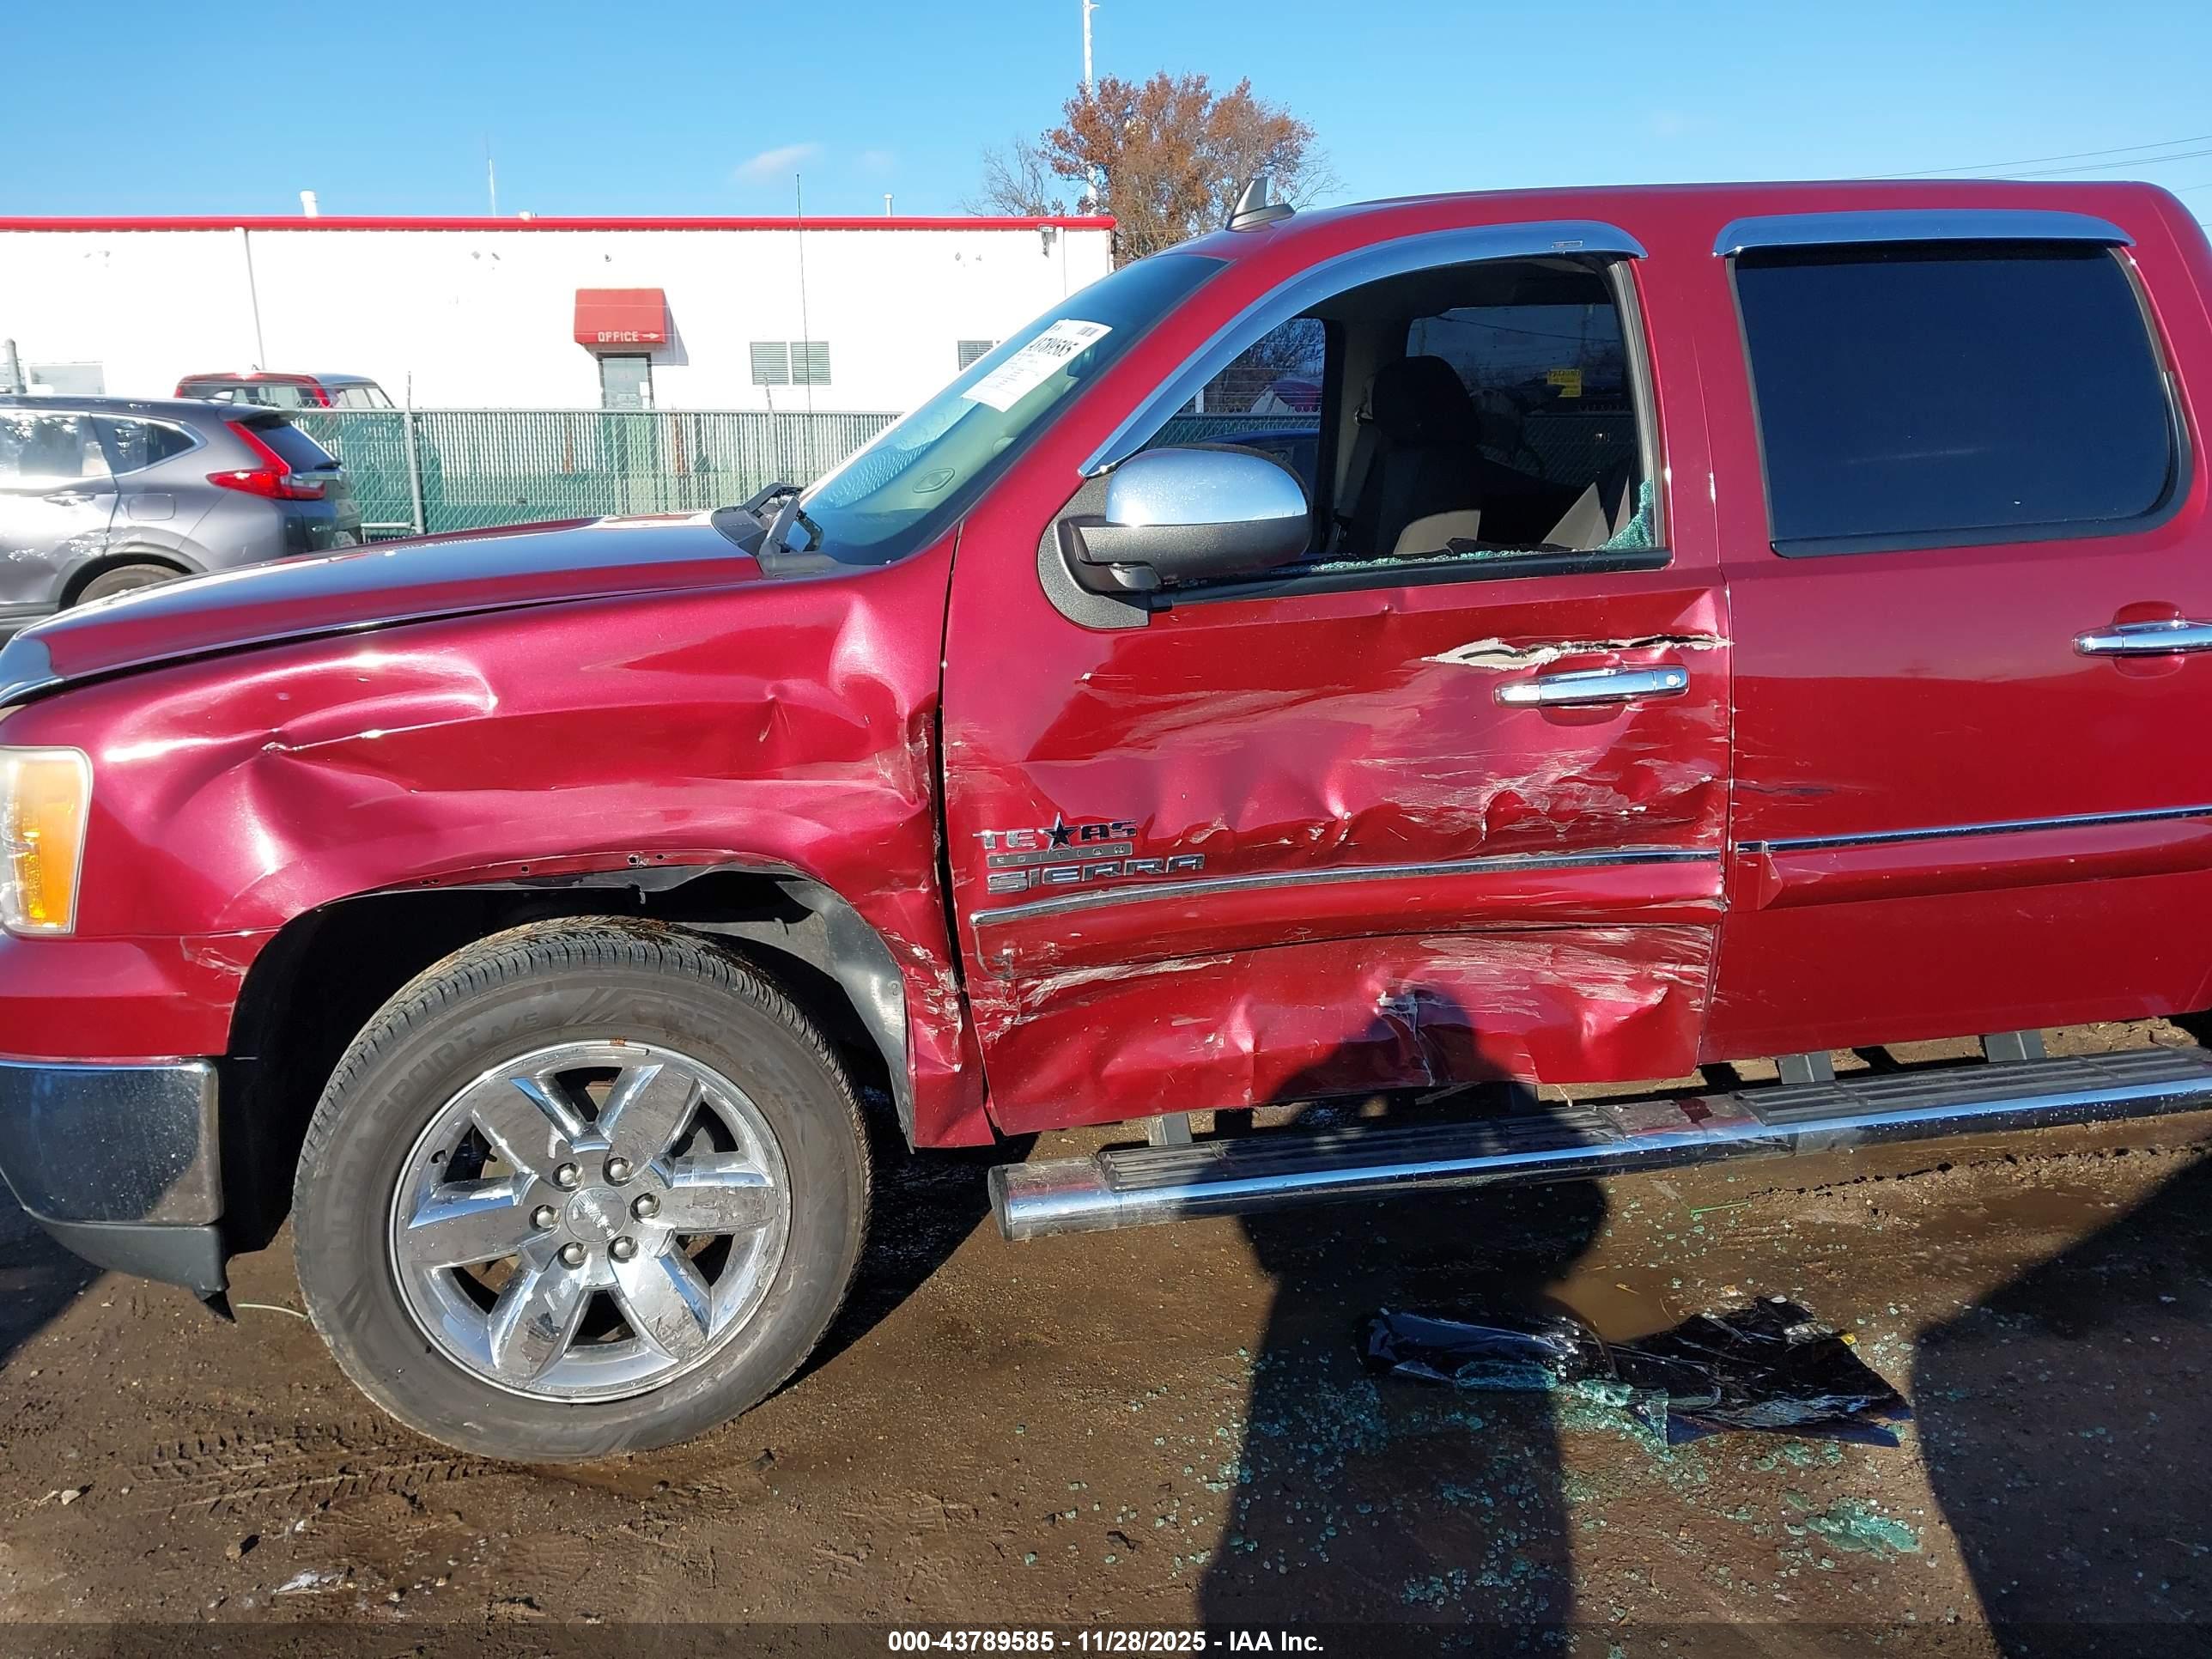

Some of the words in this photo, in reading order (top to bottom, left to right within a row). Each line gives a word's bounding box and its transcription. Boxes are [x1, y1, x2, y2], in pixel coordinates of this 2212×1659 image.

[598, 331, 639, 342] OFFICE
[997, 845, 1125, 864] EDITION
[987, 854, 1206, 894] SIERRA
[371, 1027, 477, 1127] SPORT
[489, 1012, 541, 1042] A/S
